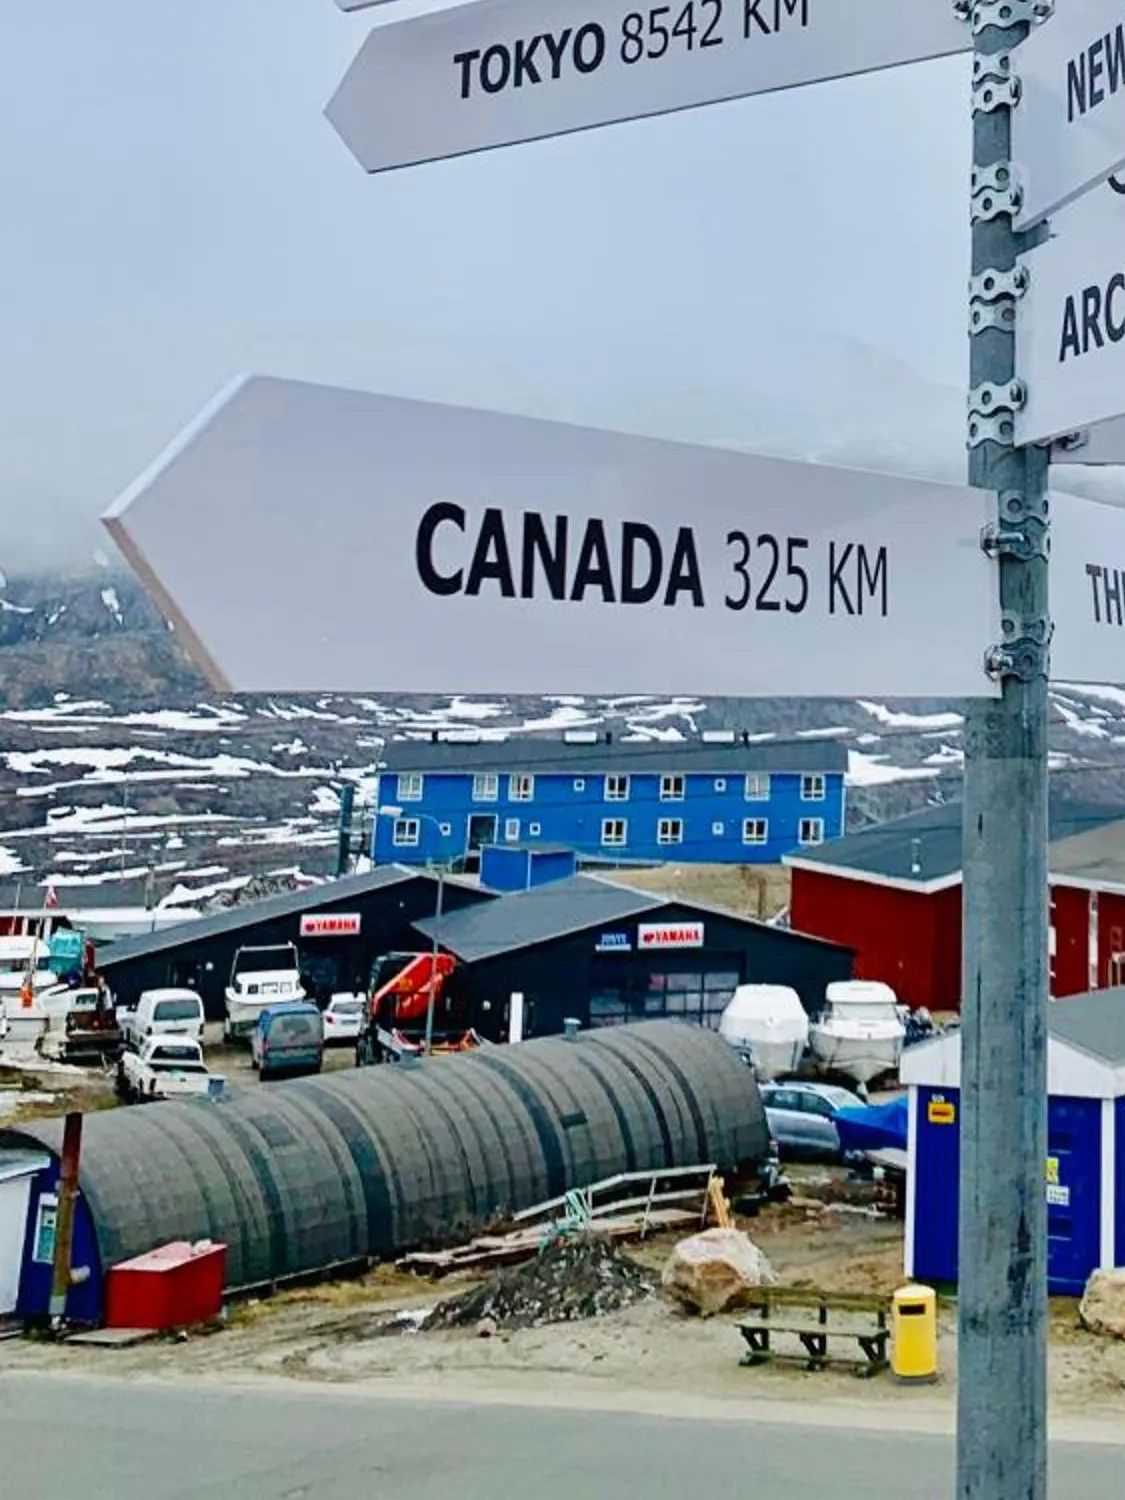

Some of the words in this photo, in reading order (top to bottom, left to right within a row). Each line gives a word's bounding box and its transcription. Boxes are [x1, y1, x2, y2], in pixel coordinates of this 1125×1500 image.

[453, 23, 602, 99] TOKYO
[415, 501, 706, 607] CANADA
[725, 530, 809, 615] 325
[828, 540, 889, 617] KM
[316, 918, 357, 931] YAMAHA
[655, 929, 699, 944] YAMAHA
